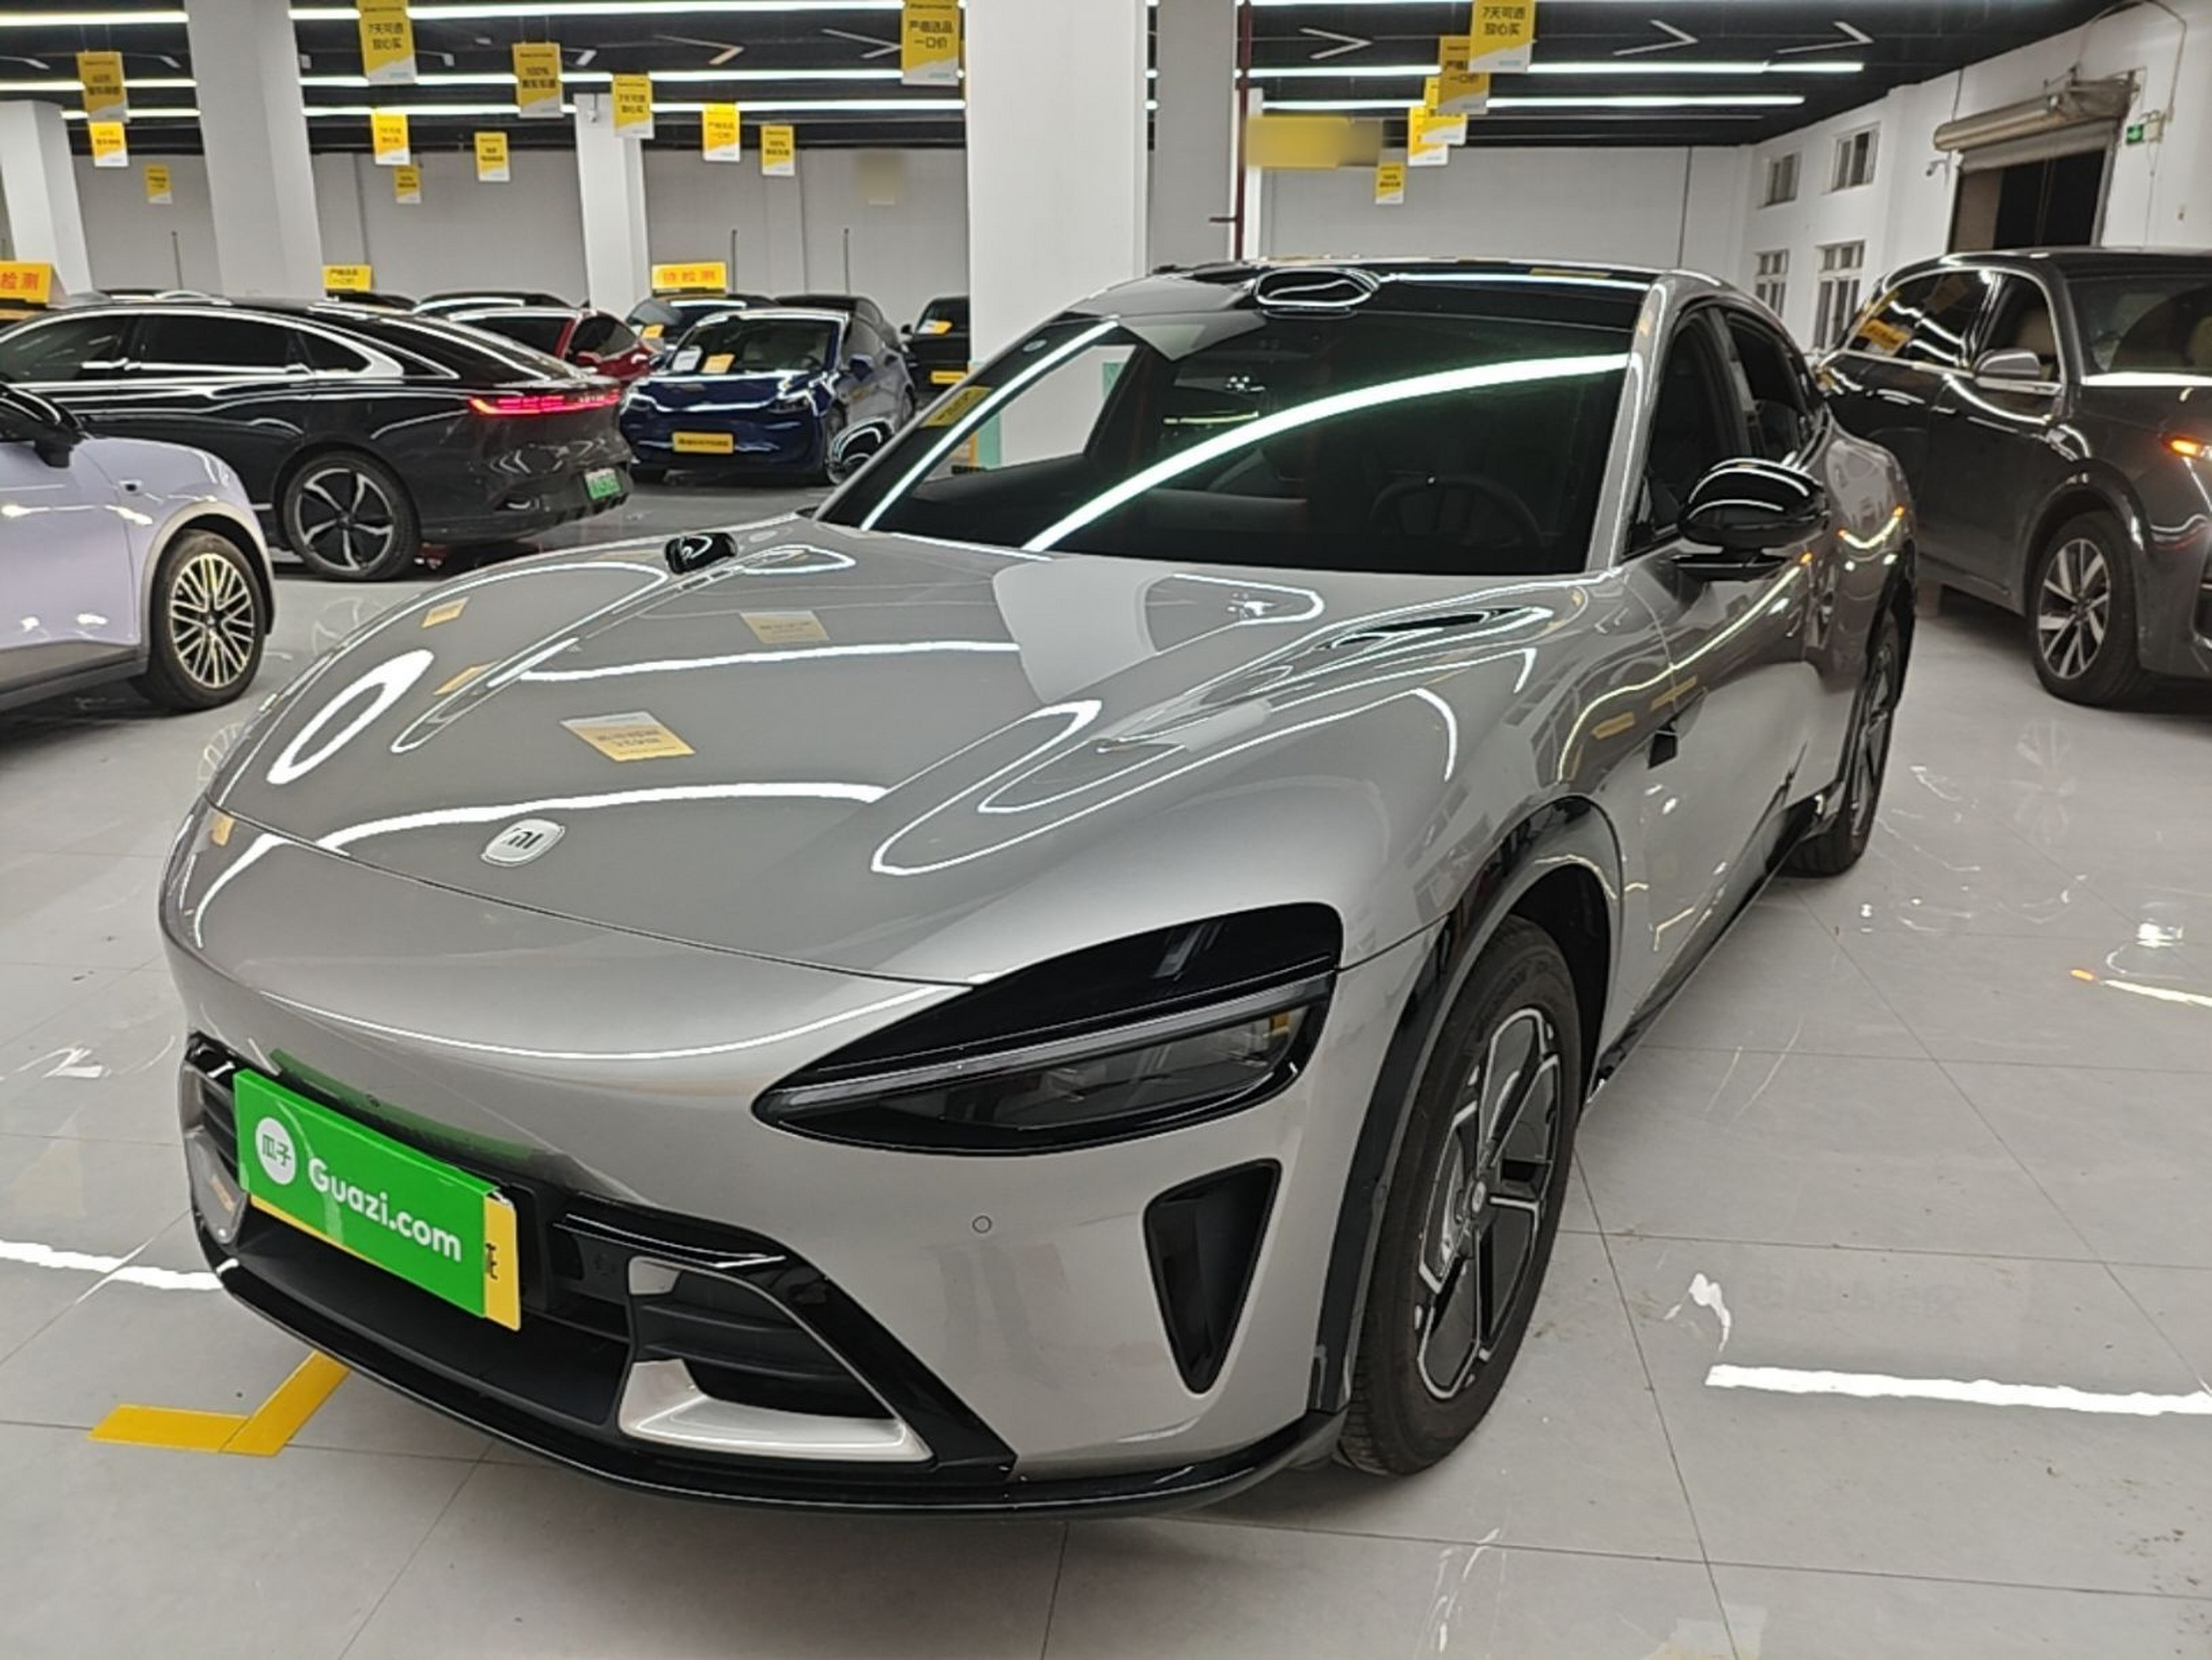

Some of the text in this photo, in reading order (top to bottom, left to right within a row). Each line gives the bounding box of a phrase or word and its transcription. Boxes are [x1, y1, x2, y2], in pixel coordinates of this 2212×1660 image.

[1482, 6, 1525, 19] 7天可退
[1484, 22, 1520, 35] 放心买
[914, 36, 948, 50] 一口价
[262, 1133, 291, 1167] 瓜子
[308, 1158, 462, 1263] Guazi.com
